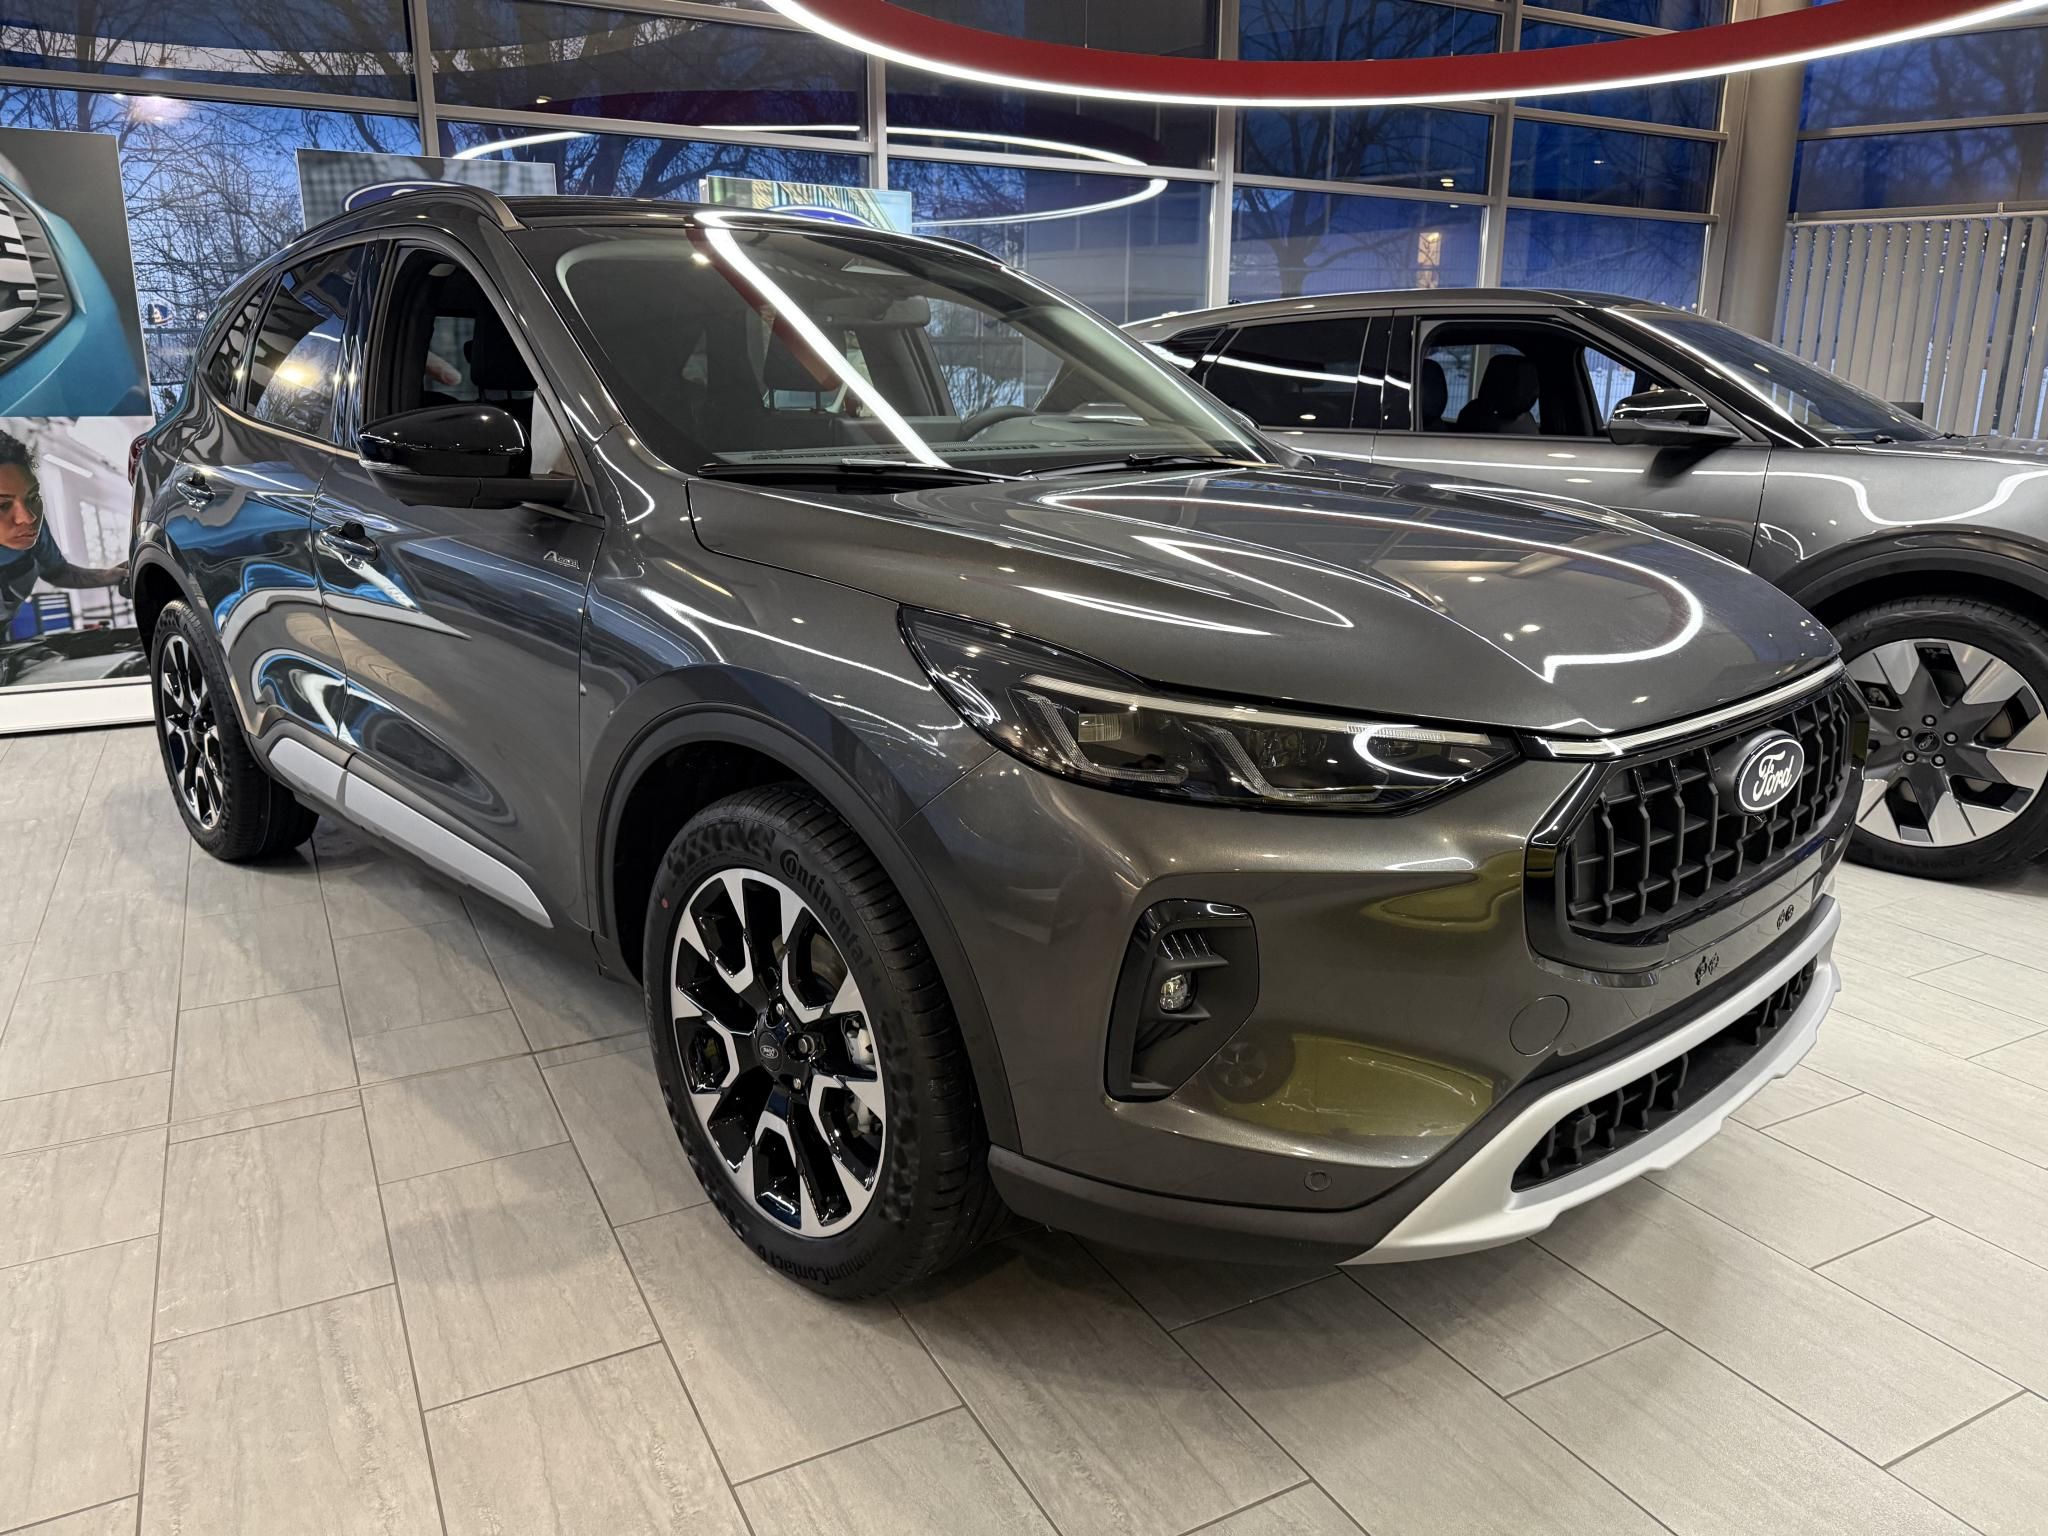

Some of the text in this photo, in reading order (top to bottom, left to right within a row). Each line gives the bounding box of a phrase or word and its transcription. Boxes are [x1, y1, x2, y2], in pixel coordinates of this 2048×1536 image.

[1753, 750, 1794, 801] Ford
[779, 849, 873, 969] Continental
[769, 1248, 880, 1286] emiumContact
